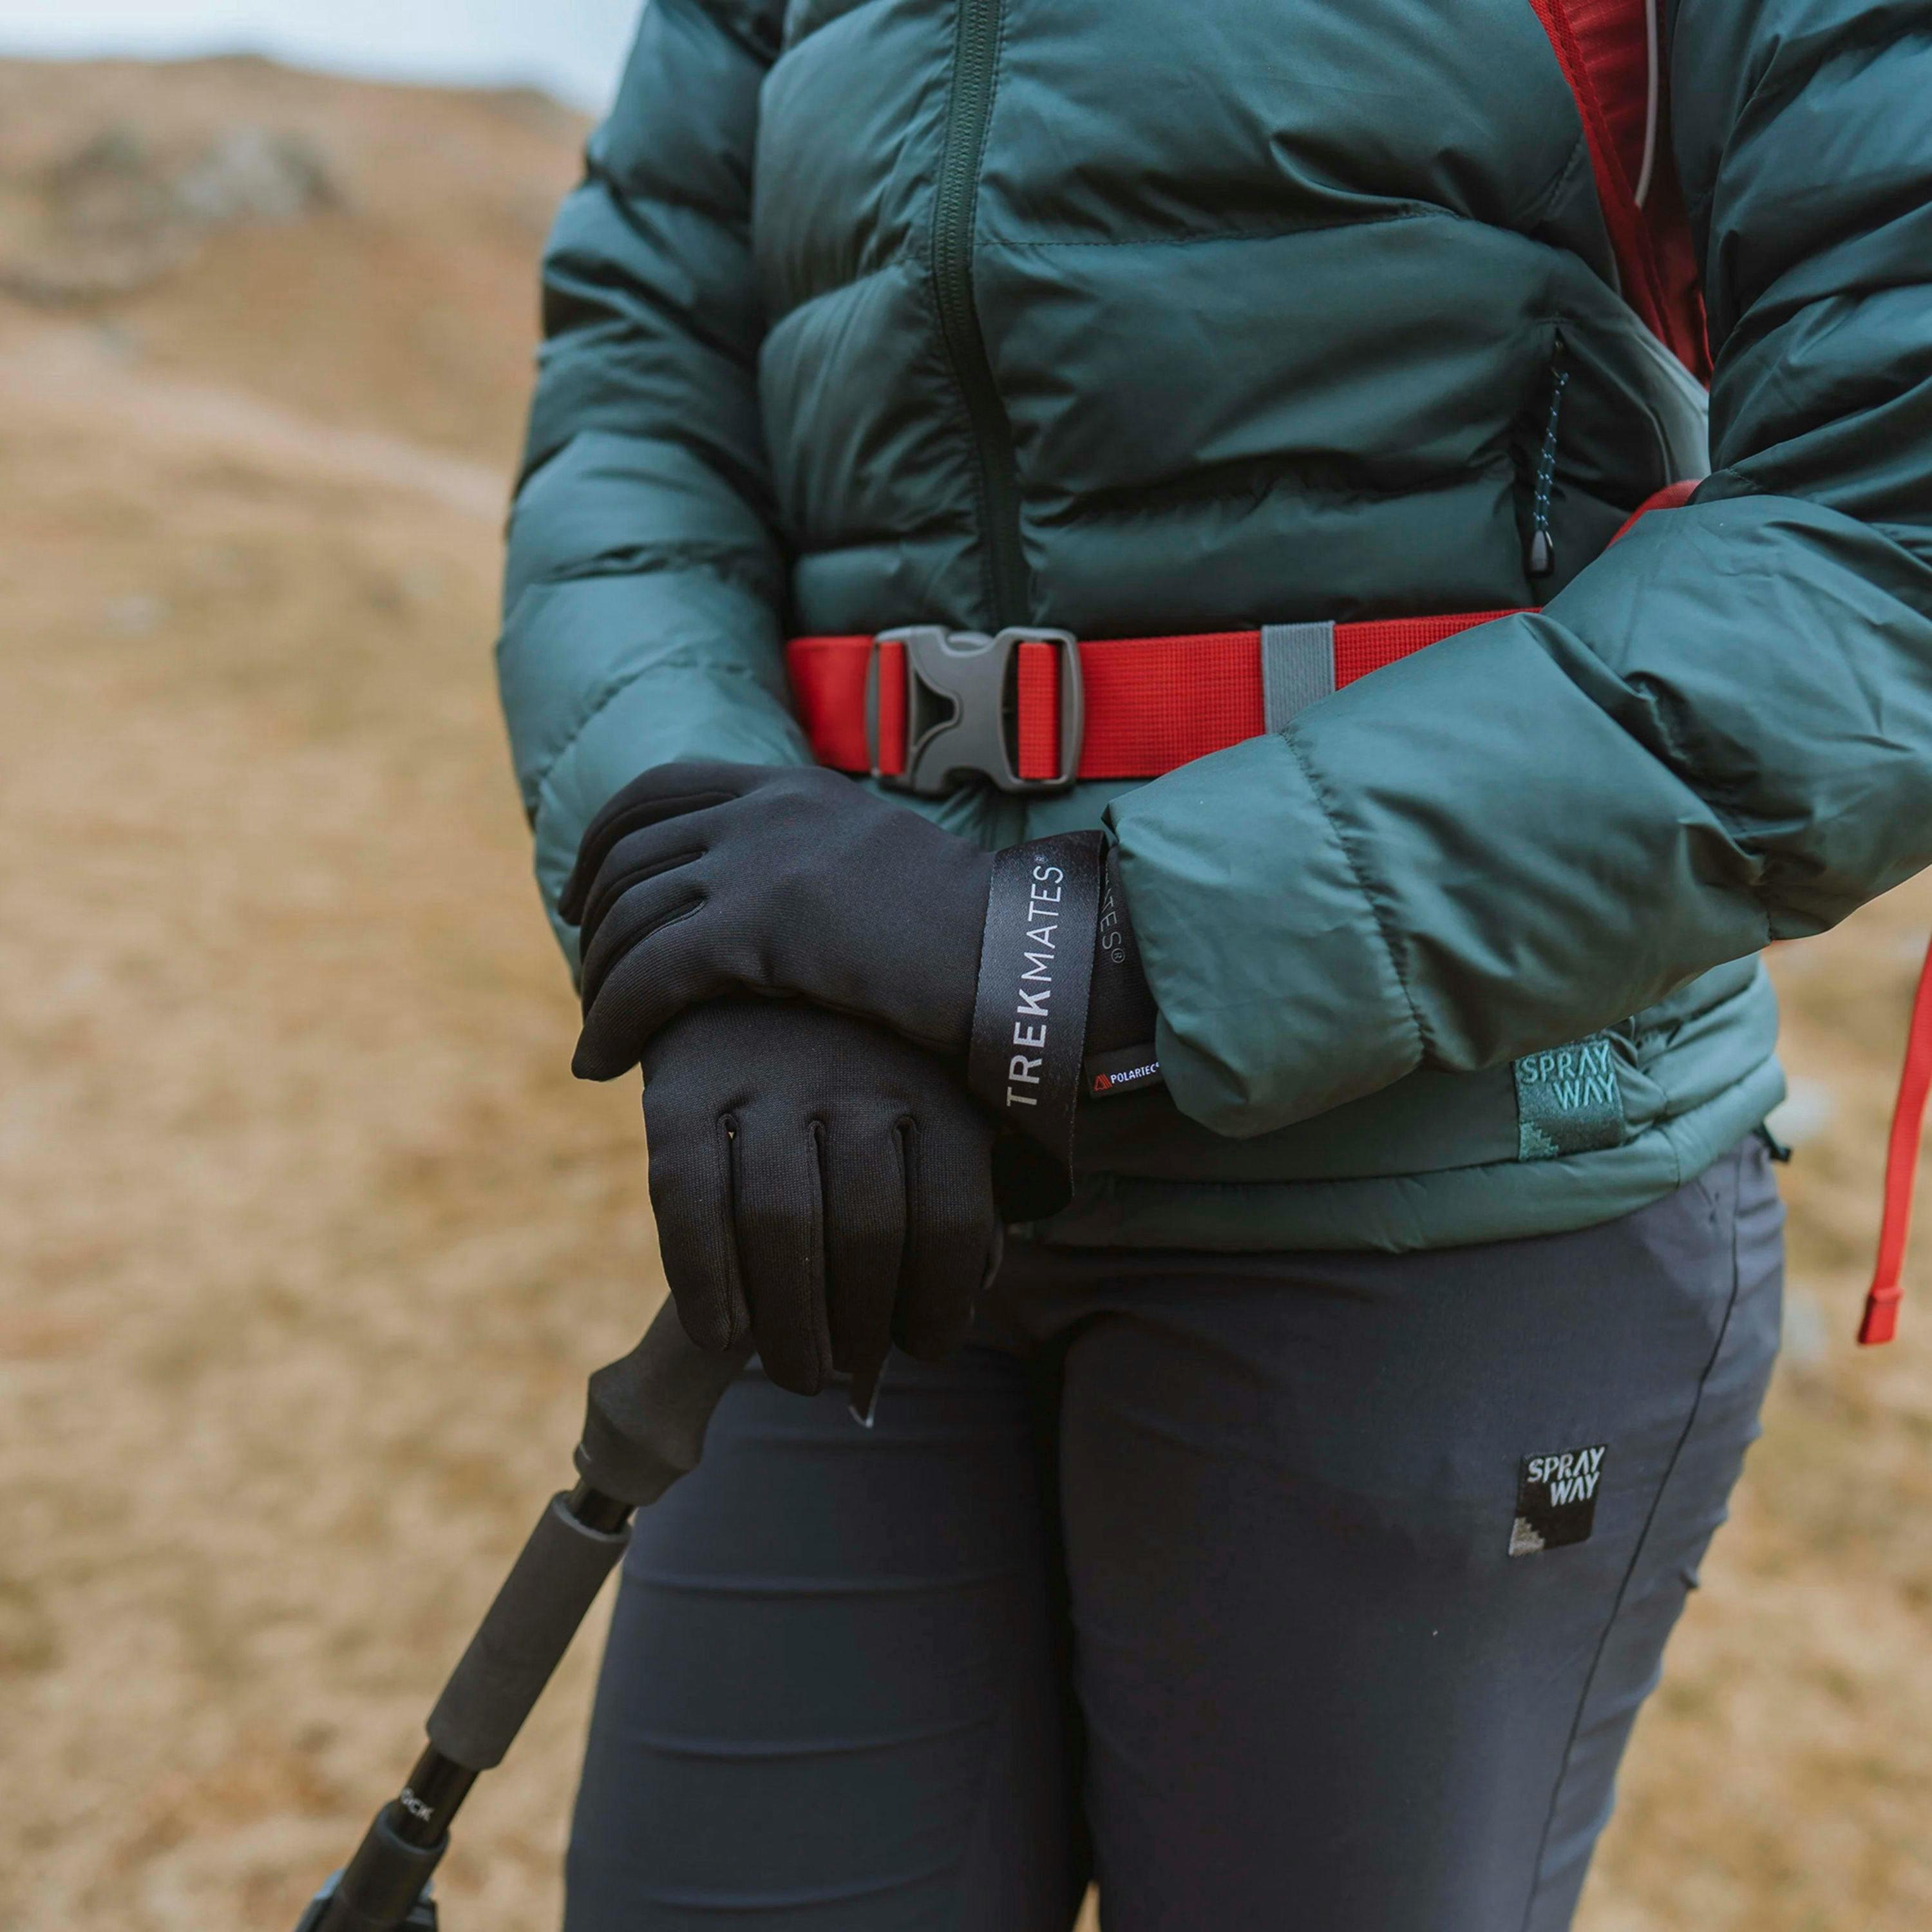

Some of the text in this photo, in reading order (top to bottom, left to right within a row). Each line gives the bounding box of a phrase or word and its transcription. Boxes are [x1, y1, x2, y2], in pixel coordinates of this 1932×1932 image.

[1520, 1043, 1609, 1083] SPRAY
[1552, 1072, 1615, 1110] WAY
[1526, 1446, 1605, 1484] SPRAY
[1550, 1470, 1600, 1508] WAY
